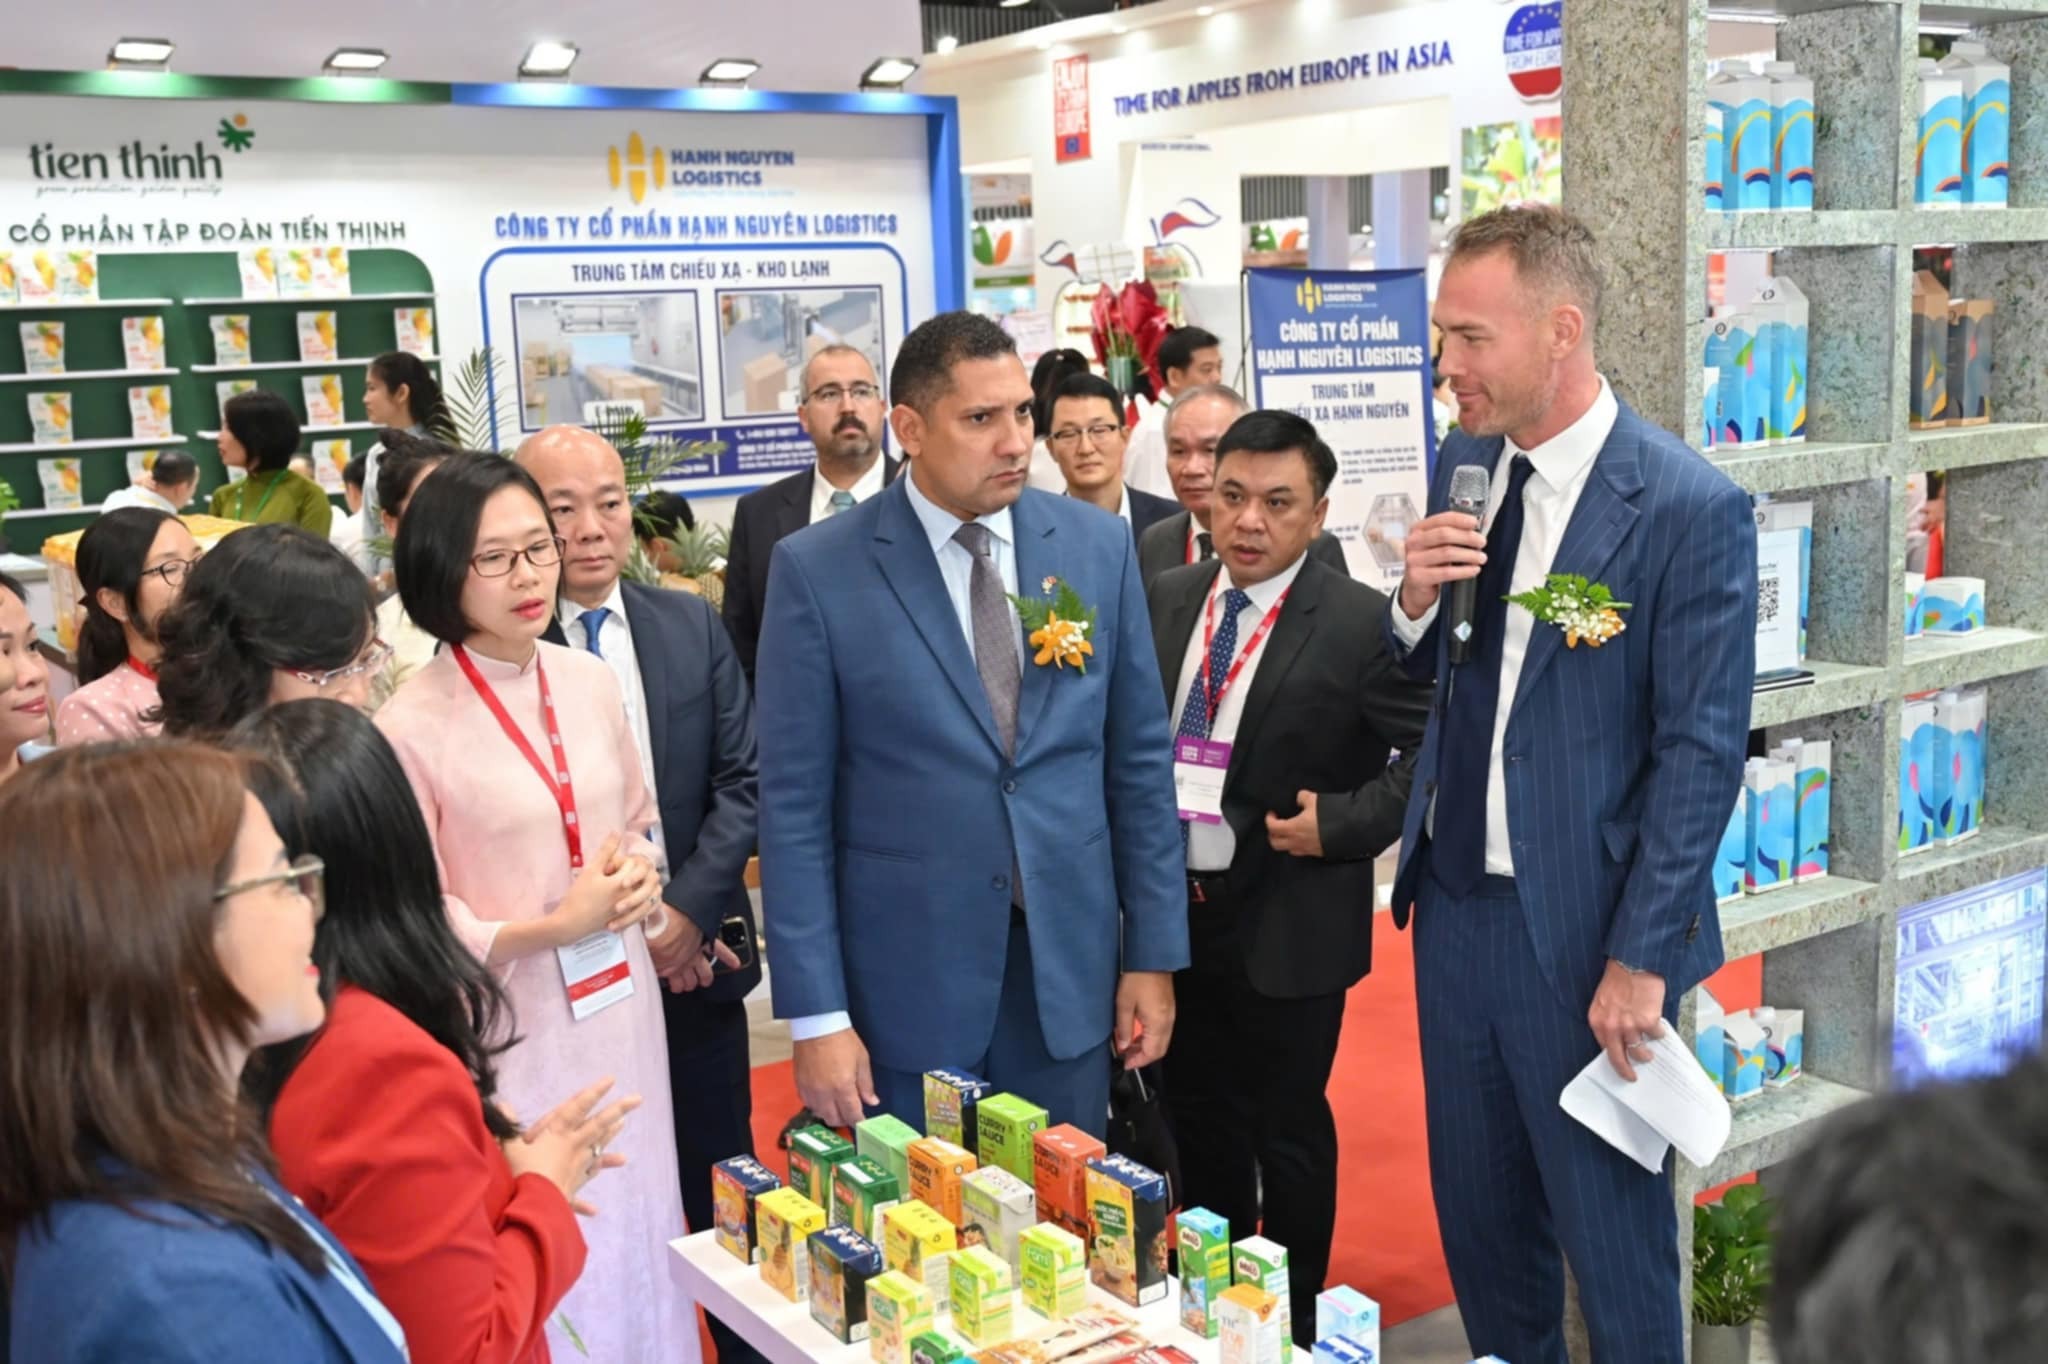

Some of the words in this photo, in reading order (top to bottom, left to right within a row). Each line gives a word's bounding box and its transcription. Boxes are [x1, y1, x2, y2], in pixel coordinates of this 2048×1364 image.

[1114, 93, 1147, 116] TIME
[1152, 87, 1181, 110] FOR
[1187, 77, 1240, 104] APPLES
[1246, 66, 1294, 94] FROM
[1300, 53, 1370, 86] EUROPE
[1377, 49, 1398, 75] IN
[1406, 40, 1453, 71] ASIA
[29, 143, 109, 179] tien
[119, 140, 222, 179] thinh
[671, 150, 721, 166] HANH
[725, 150, 794, 166] NGUYEN
[672, 171, 762, 186] LOGISTICS
[9, 212, 50, 244] CỔ
[143, 218, 189, 247] TẬP
[200, 218, 272, 241] ĐOÀN
[280, 214, 328, 240] TIẾN
[336, 219, 405, 246] THỊNH
[495, 212, 548, 239] CÔNG
[557, 215, 579, 239] TY
[679, 215, 727, 241] HẠNH
[735, 211, 807, 237] NGUYÊN
[814, 213, 897, 236] LOGISTICS
[572, 263, 625, 282] TRUNG
[632, 260, 665, 281] TÂM
[721, 262, 741, 283] XẠ
[757, 261, 786, 277] KHO
[792, 261, 829, 281] LẠNH
[1280, 318, 1317, 343] CÔNG
[1320, 321, 1336, 341] TY
[1257, 348, 1296, 373] HẠNH
[1298, 344, 1353, 369] NGUYÊN
[1356, 346, 1423, 367] LOGISTICS
[1312, 384, 1348, 400] TRUNG
[1352, 380, 1375, 398] TÂM
[1333, 403, 1363, 424] HẠNH
[1366, 400, 1409, 419] NGUYÊN
[979, 1114, 1005, 1133] CURRY
[979, 1127, 1005, 1146] SAUCE
